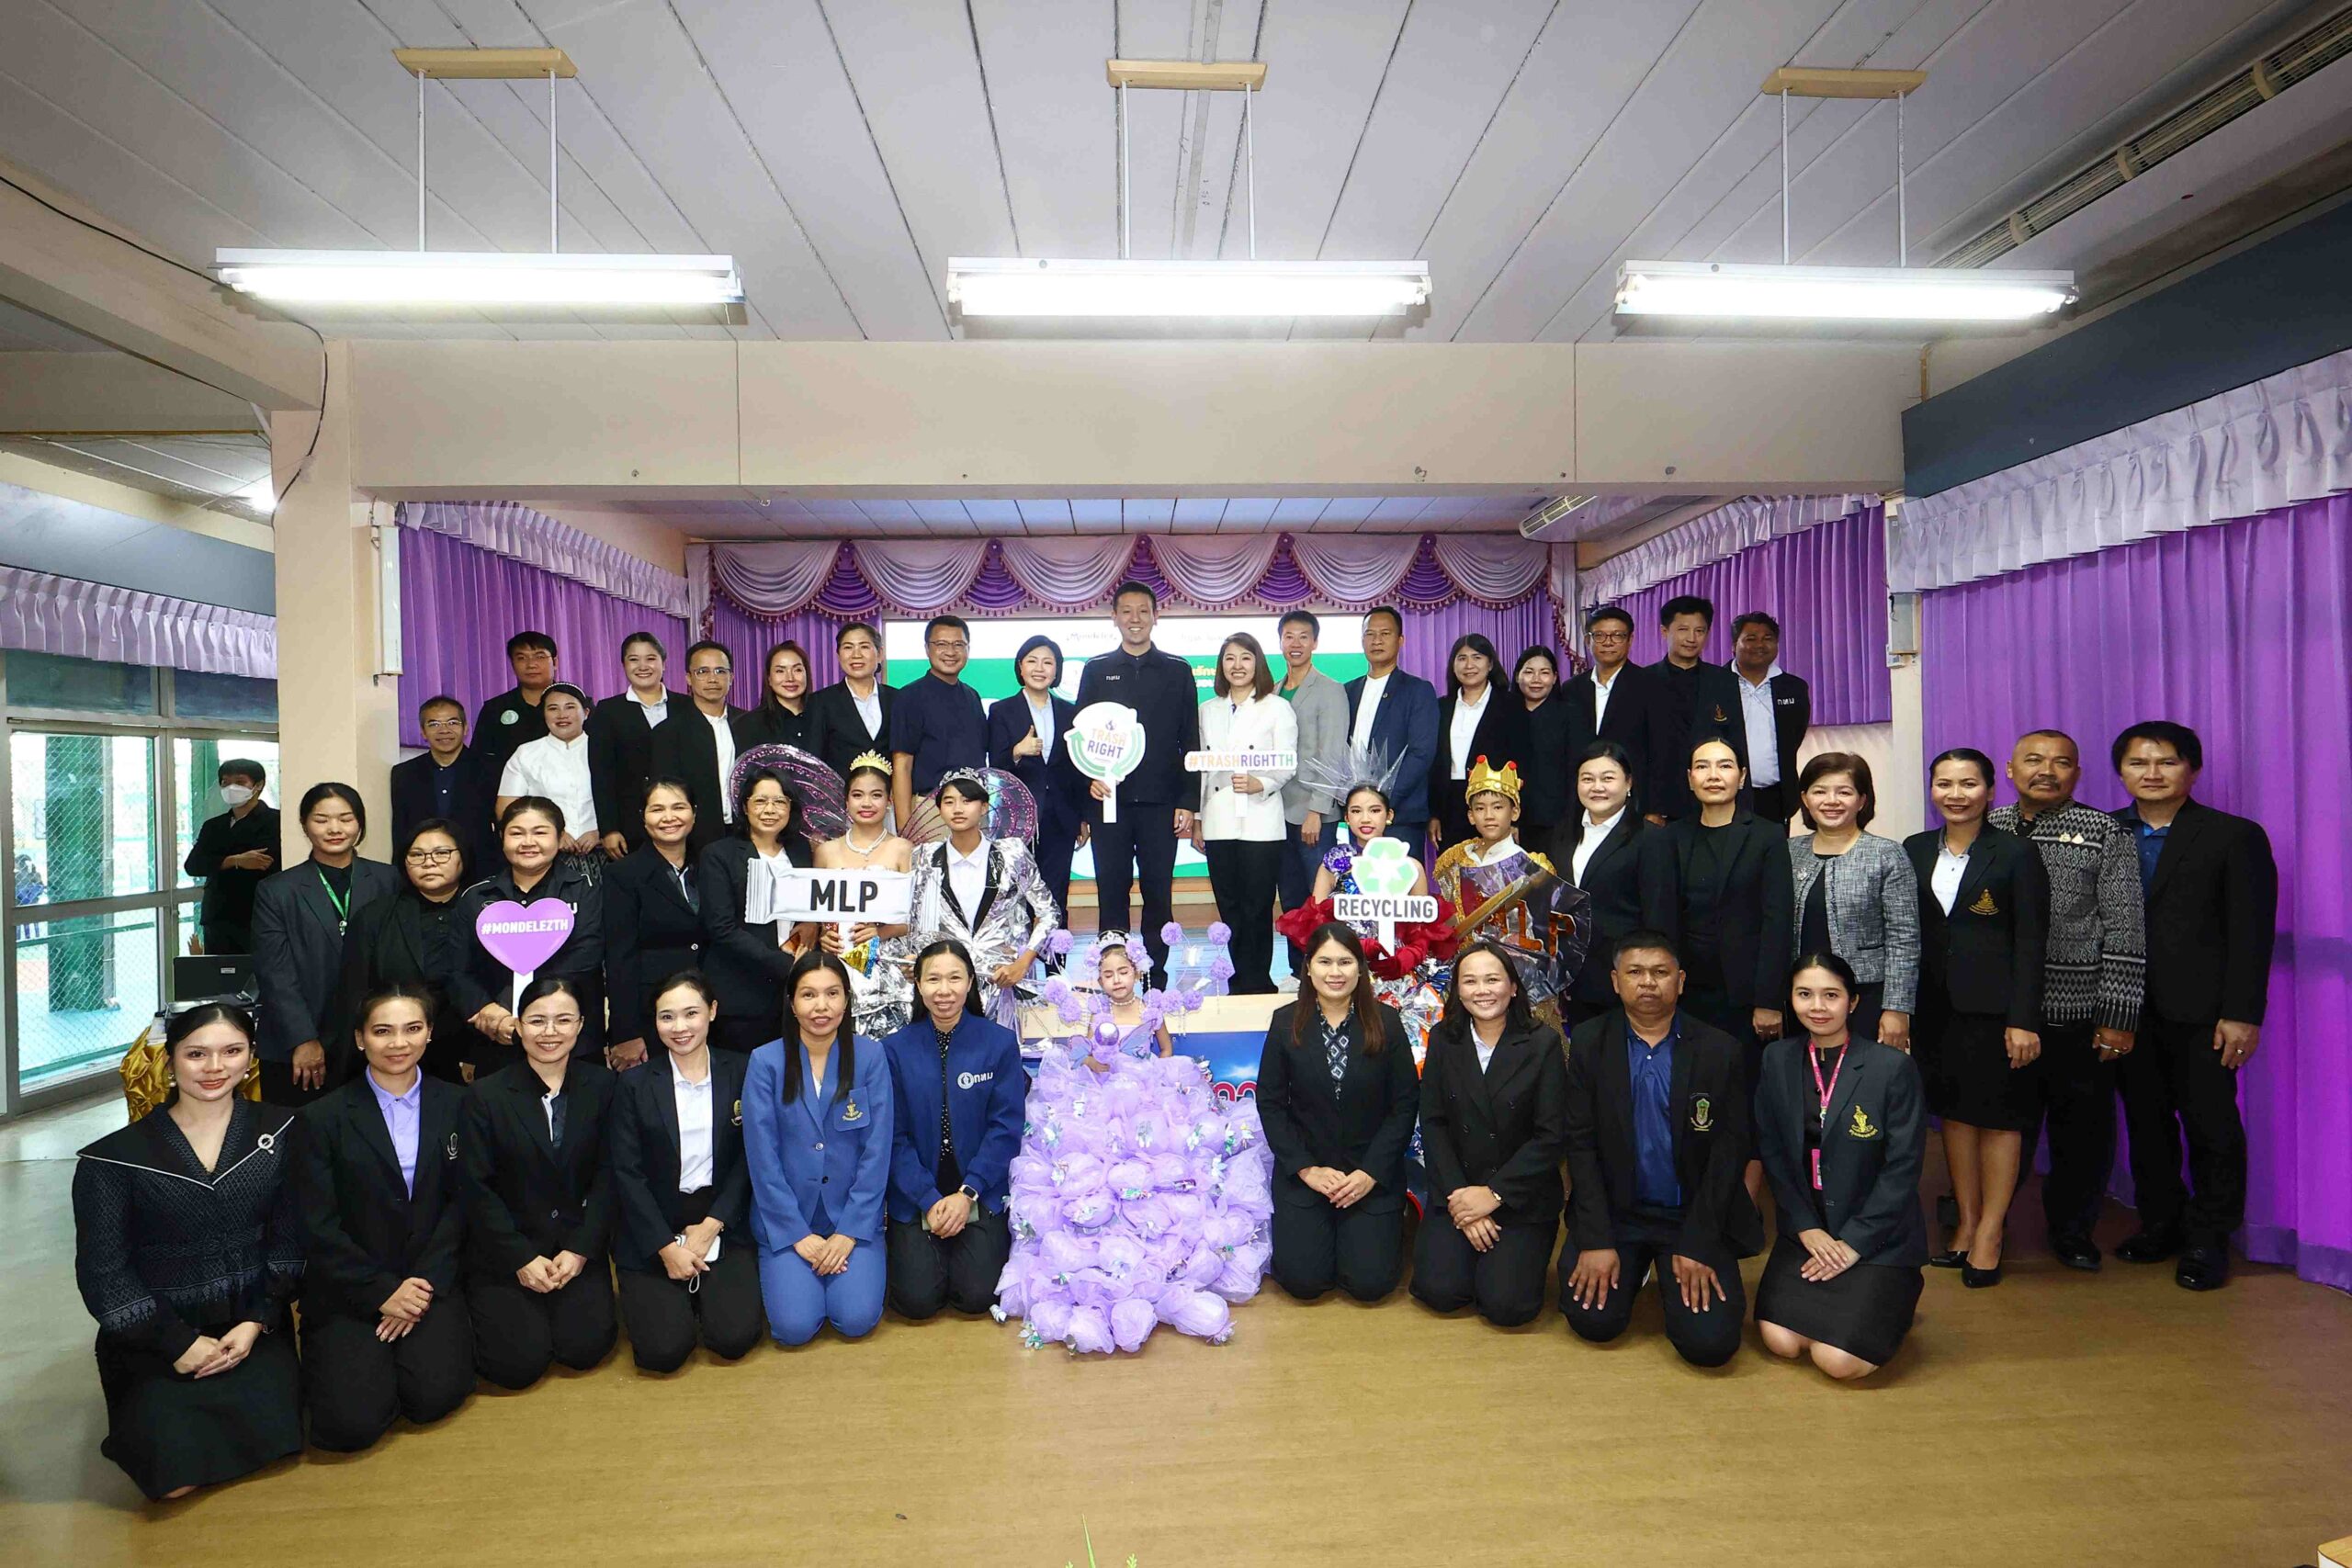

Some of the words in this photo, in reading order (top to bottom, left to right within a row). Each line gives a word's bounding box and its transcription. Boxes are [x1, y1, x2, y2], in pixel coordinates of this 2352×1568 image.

[1777, 697, 1794, 705] กทม
[1091, 728, 1127, 747] TRASH
[1087, 739, 1124, 759] RIGHT
[1188, 753, 1294, 768] #TRASHRIGHTTH
[810, 879, 878, 912] MLP
[1338, 898, 1433, 919] RECYCLING
[481, 919, 569, 935] #MONDELEZTH
[974, 1072, 993, 1083] กทม
